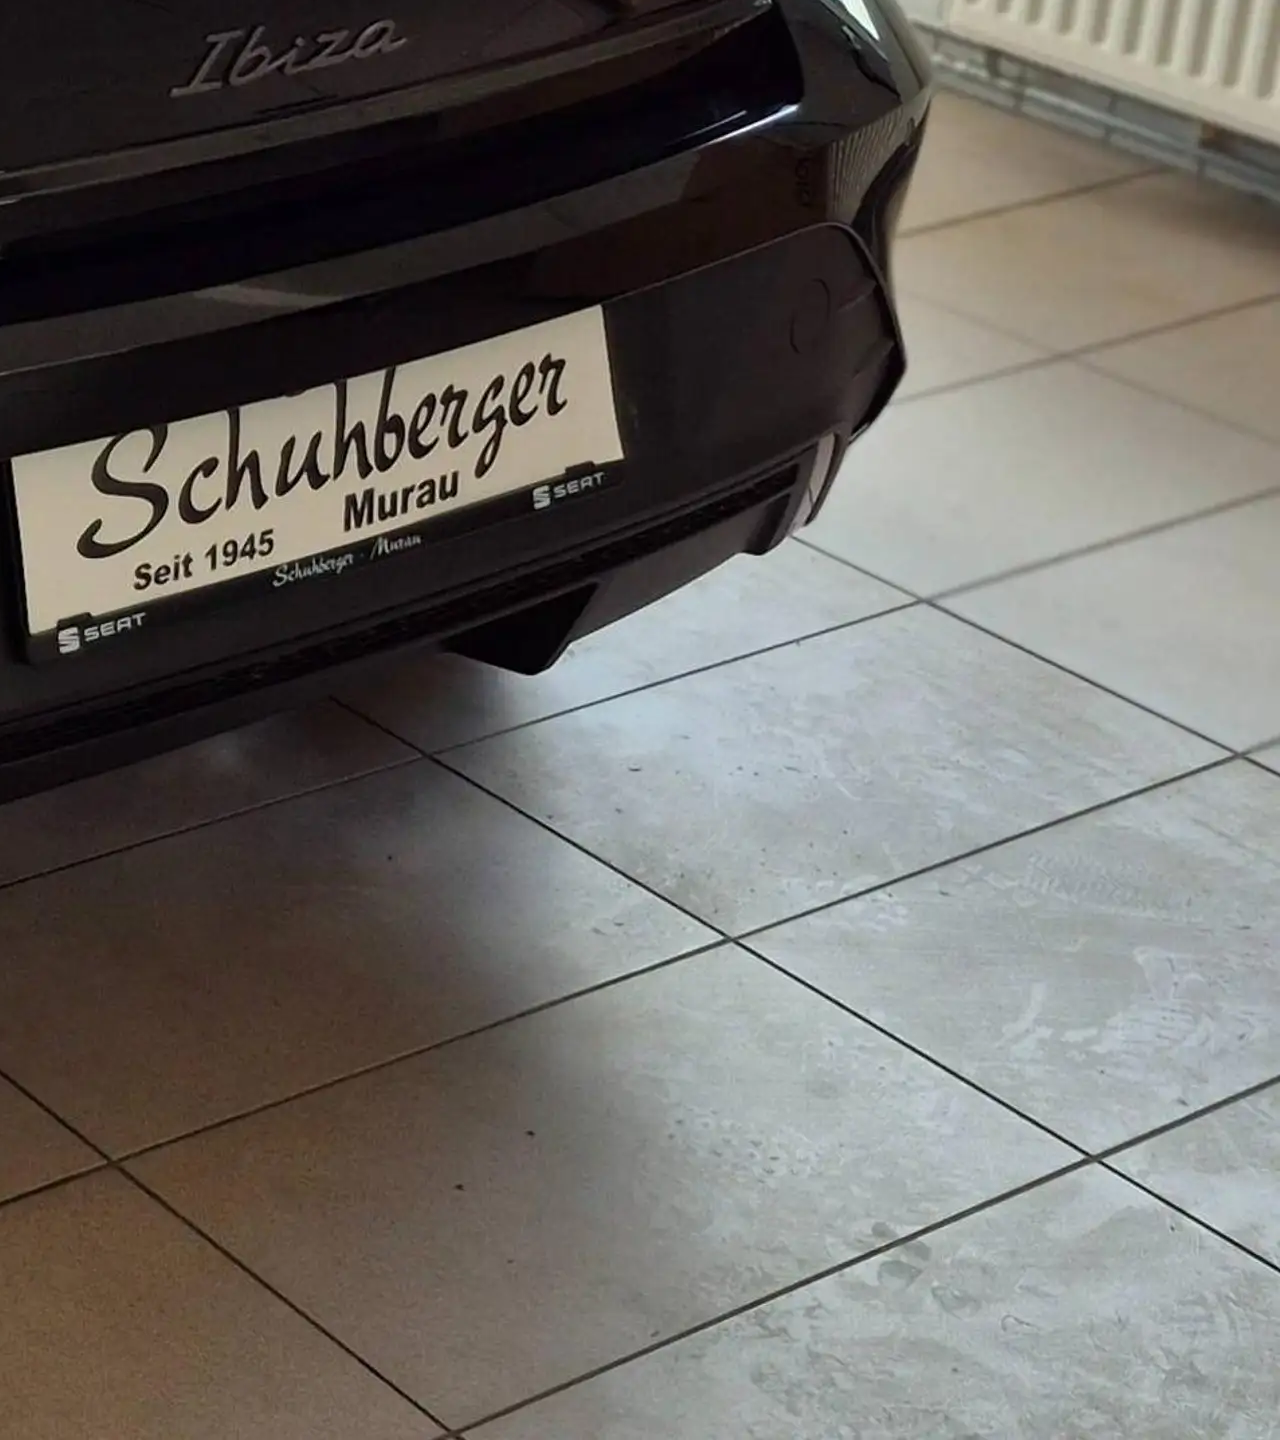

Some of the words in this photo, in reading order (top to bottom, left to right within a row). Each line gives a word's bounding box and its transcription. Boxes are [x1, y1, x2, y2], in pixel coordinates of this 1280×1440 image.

[169, 16, 410, 98] Ibiza
[76, 353, 569, 560] Schuhberger
[553, 471, 605, 499] SEAT
[342, 469, 460, 533] Murau
[132, 555, 194, 592] Seit
[204, 528, 275, 574] 1945
[272, 553, 354, 588] Schuhberger
[370, 534, 423, 561] Murau
[83, 612, 146, 642] SEAT
